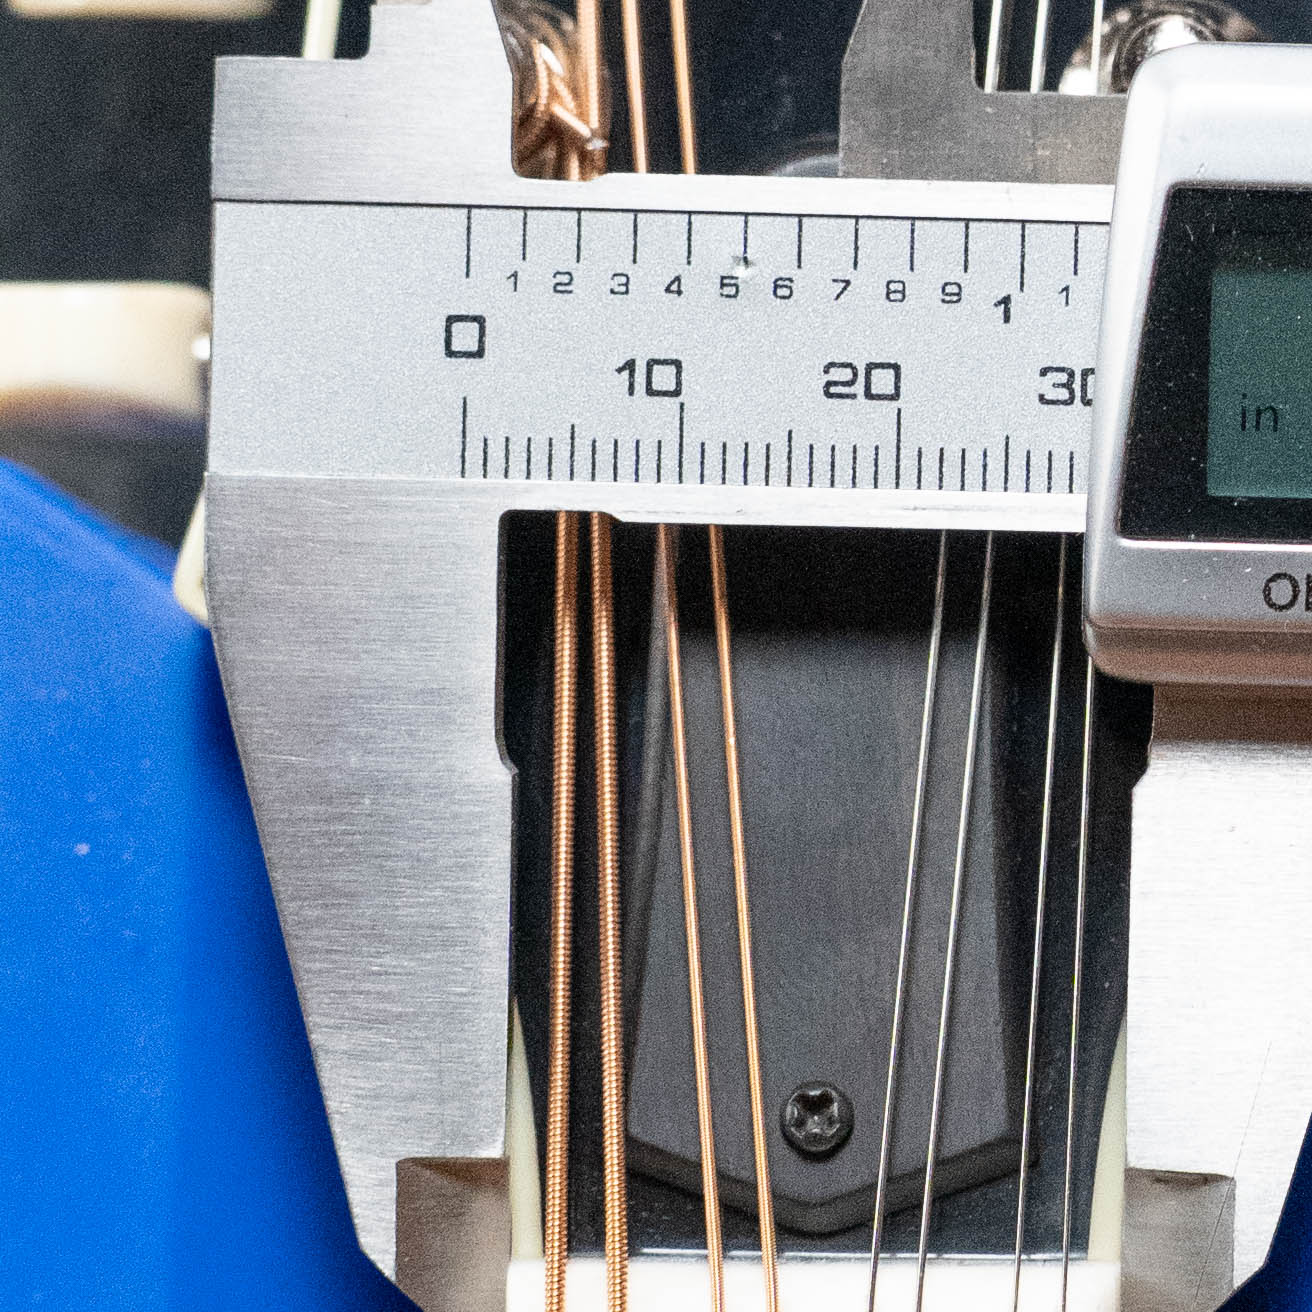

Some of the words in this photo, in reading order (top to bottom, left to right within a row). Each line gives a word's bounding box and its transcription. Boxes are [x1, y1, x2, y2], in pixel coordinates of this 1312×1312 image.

[506, 270, 519, 292] 1
[552, 270, 574, 294] 2
[609, 272, 630, 295] 3
[664, 275, 683, 296] 4
[719, 275, 739, 298] 5
[772, 276, 794, 299] 6
[831, 278, 850, 301] 7
[885, 279, 906, 302] 8
[940, 281, 962, 304] 9
[993, 294, 1012, 324] 1
[1058, 285, 1070, 307] 1
[615, 358, 682, 397] 10
[822, 361, 901, 401] 20
[1239, 392, 1279, 432] in
